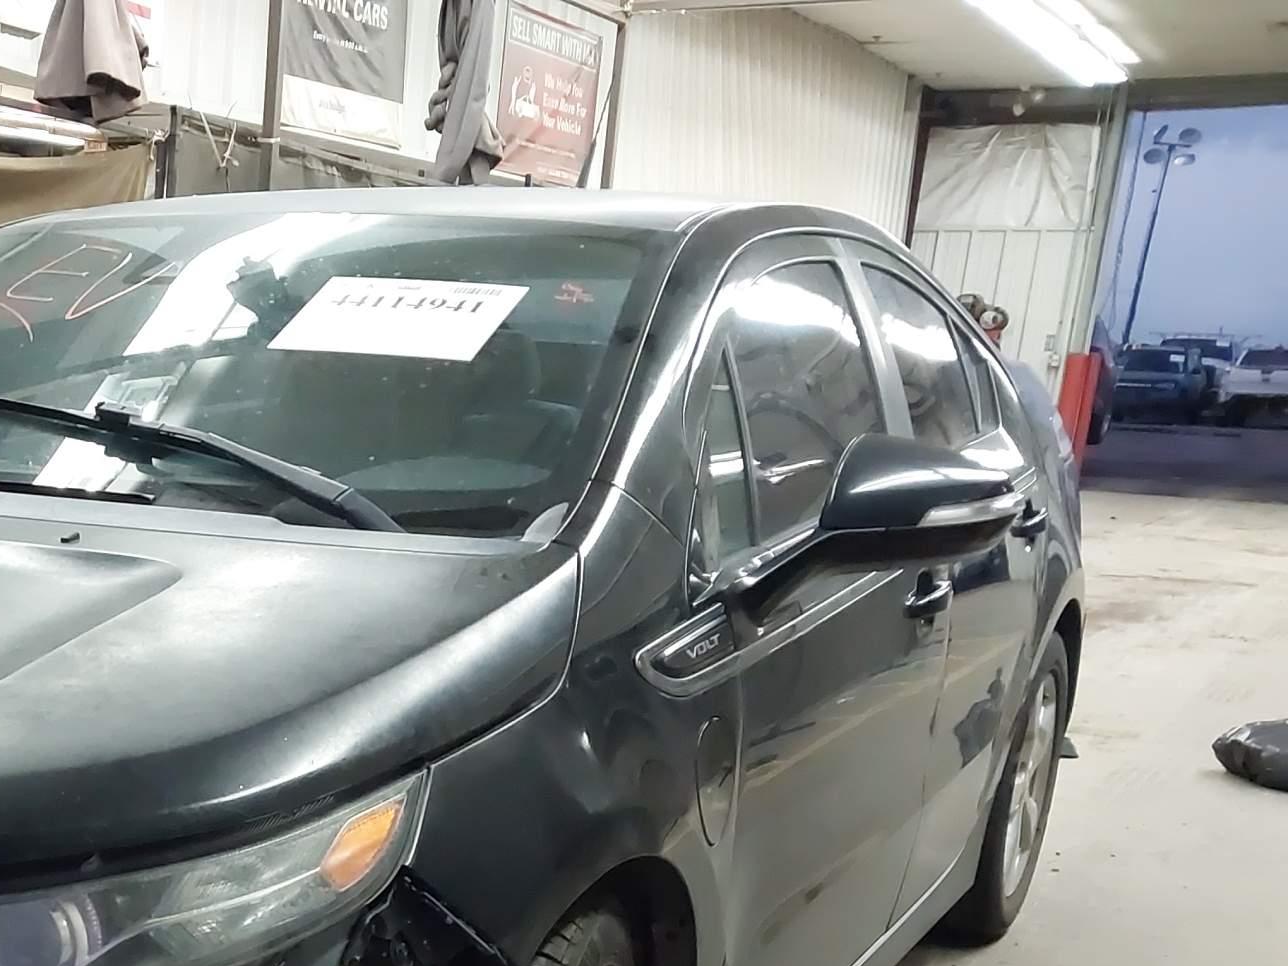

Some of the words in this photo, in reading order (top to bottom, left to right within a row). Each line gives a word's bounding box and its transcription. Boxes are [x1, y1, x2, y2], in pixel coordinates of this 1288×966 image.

[354, 0, 389, 30] CARS
[512, 15, 531, 42] SELL
[532, 23, 562, 53] SMART
[562, 36, 583, 63] WITH
[557, 116, 582, 136] Vehicle
[685, 633, 721, 659] VOLT
